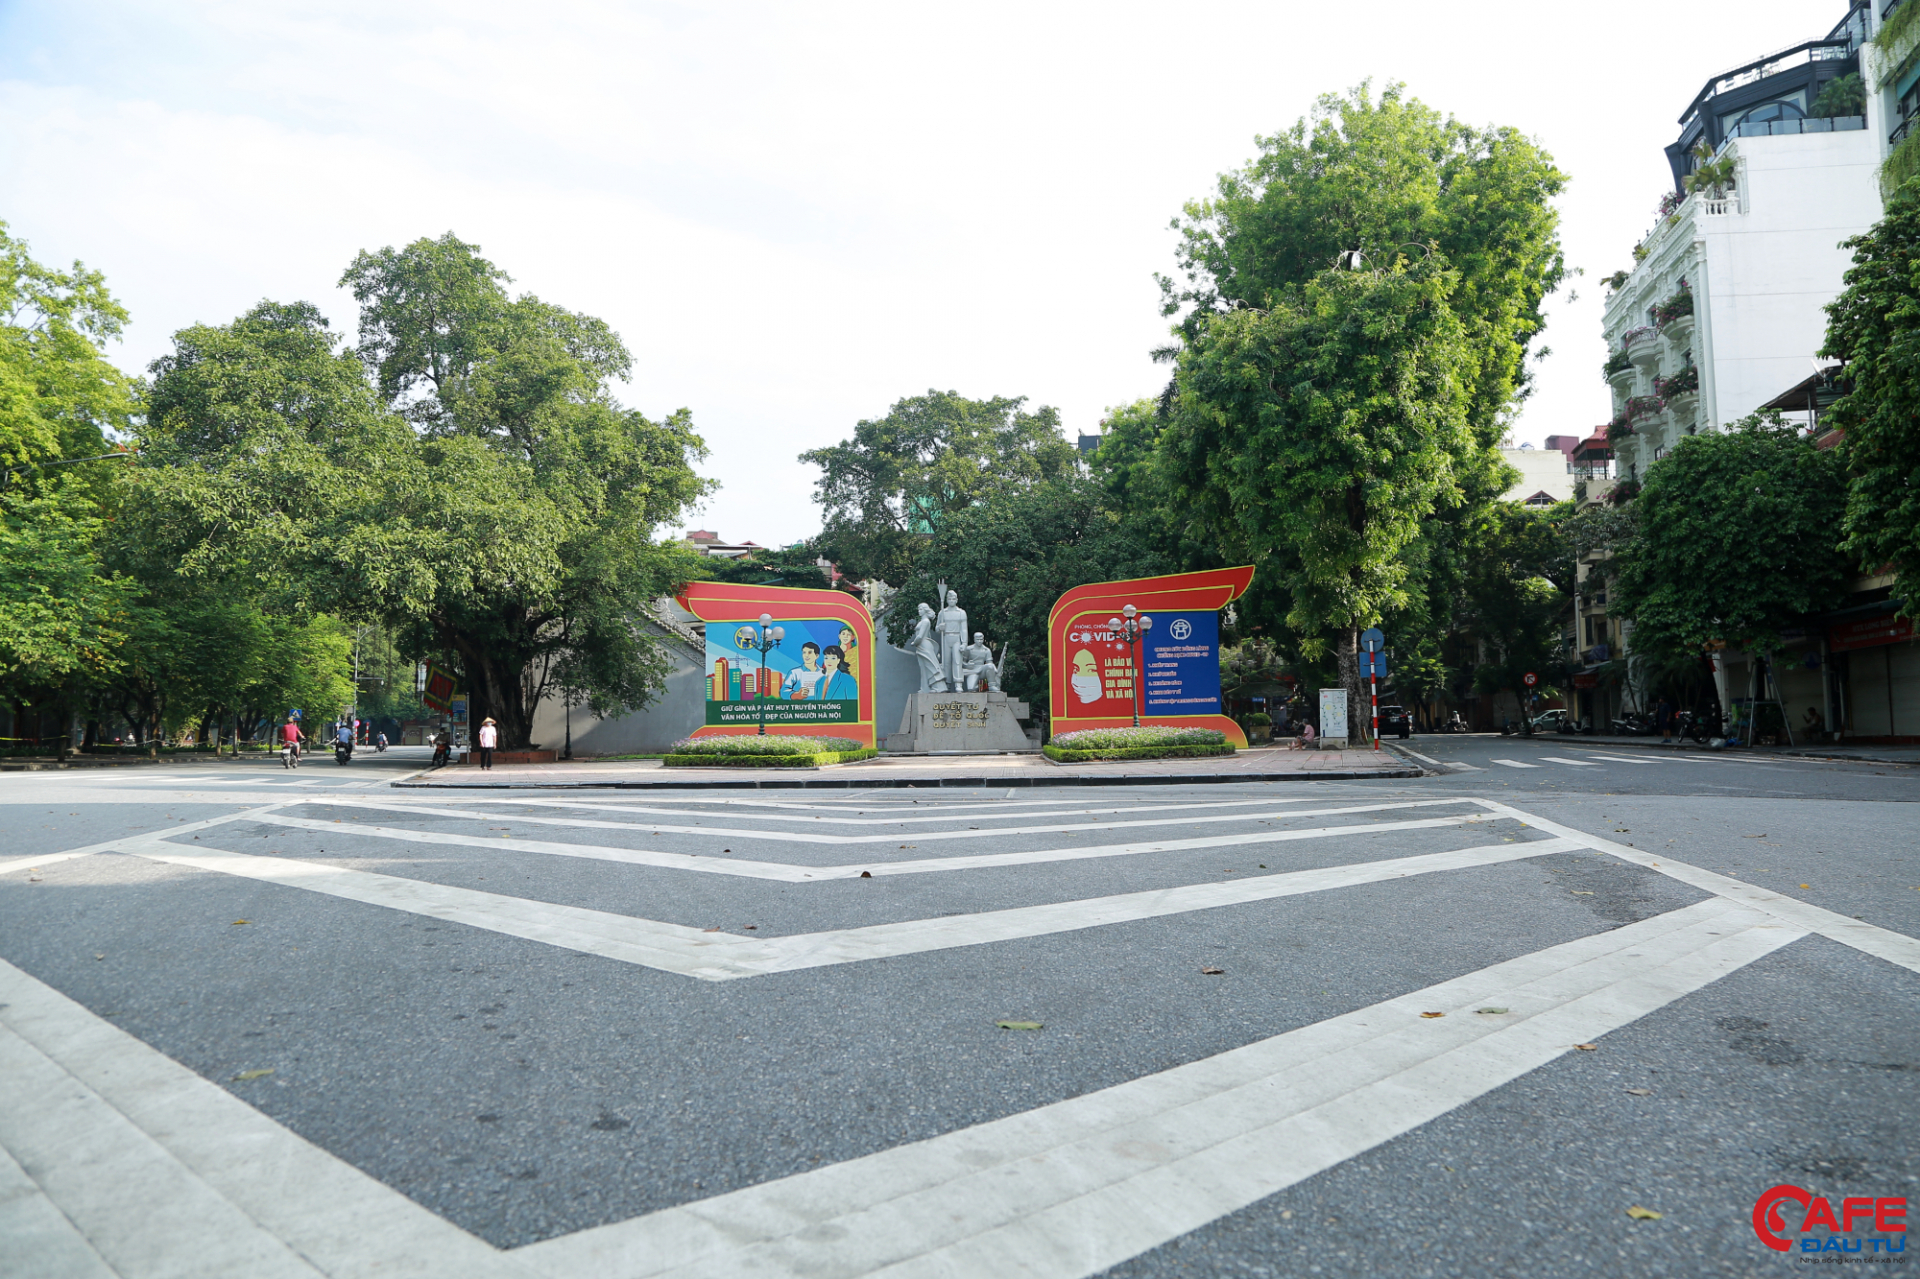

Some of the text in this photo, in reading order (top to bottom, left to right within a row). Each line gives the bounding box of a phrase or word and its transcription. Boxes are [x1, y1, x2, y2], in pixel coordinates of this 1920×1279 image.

[1105, 657, 1112, 667] LÀ
[1105, 668, 1124, 678] CHÍNH
[1105, 679, 1116, 688] GIA
[1106, 689, 1114, 699] VÀ
[721, 704, 733, 712] GIỮ
[818, 702, 841, 710] THỐNG
[751, 712, 762, 720] TỐ
[765, 713, 779, 721] ĐẸP
[828, 711, 841, 720] NỘI
